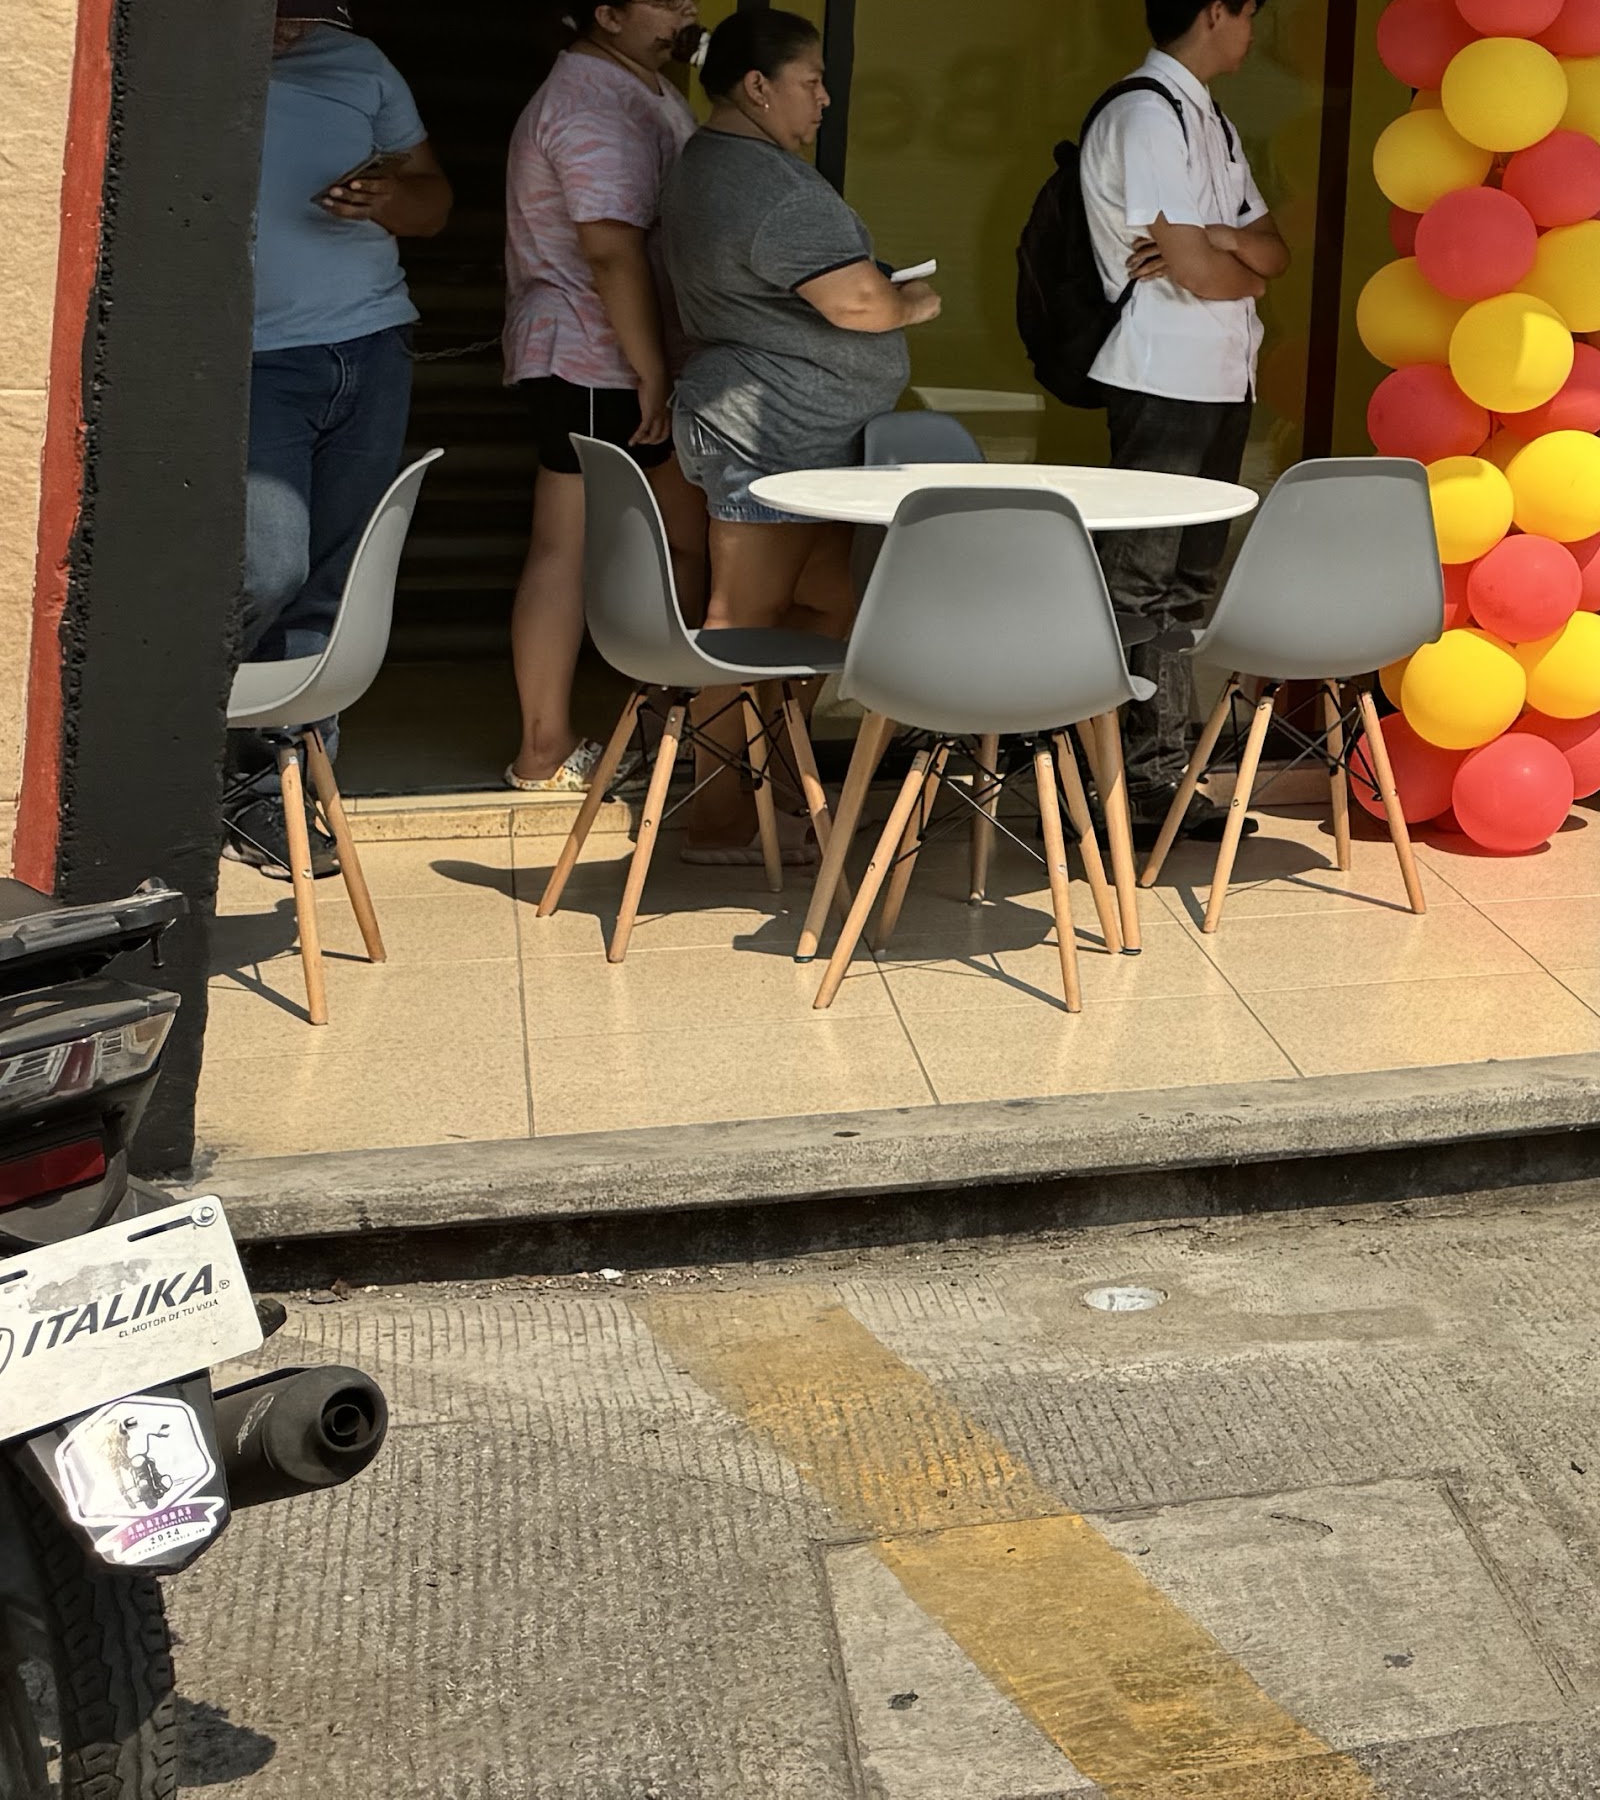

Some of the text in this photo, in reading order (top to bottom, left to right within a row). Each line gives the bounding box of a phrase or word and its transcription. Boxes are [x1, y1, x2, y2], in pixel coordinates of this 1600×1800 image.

[21, 1263, 213, 1358] ITALIKA
[118, 1329, 129, 1338] EL
[132, 1315, 167, 1334] MOTOR
[168, 1310, 181, 1322] DE
[182, 1307, 195, 1317] TU
[150, 1528, 180, 1545] 2024
